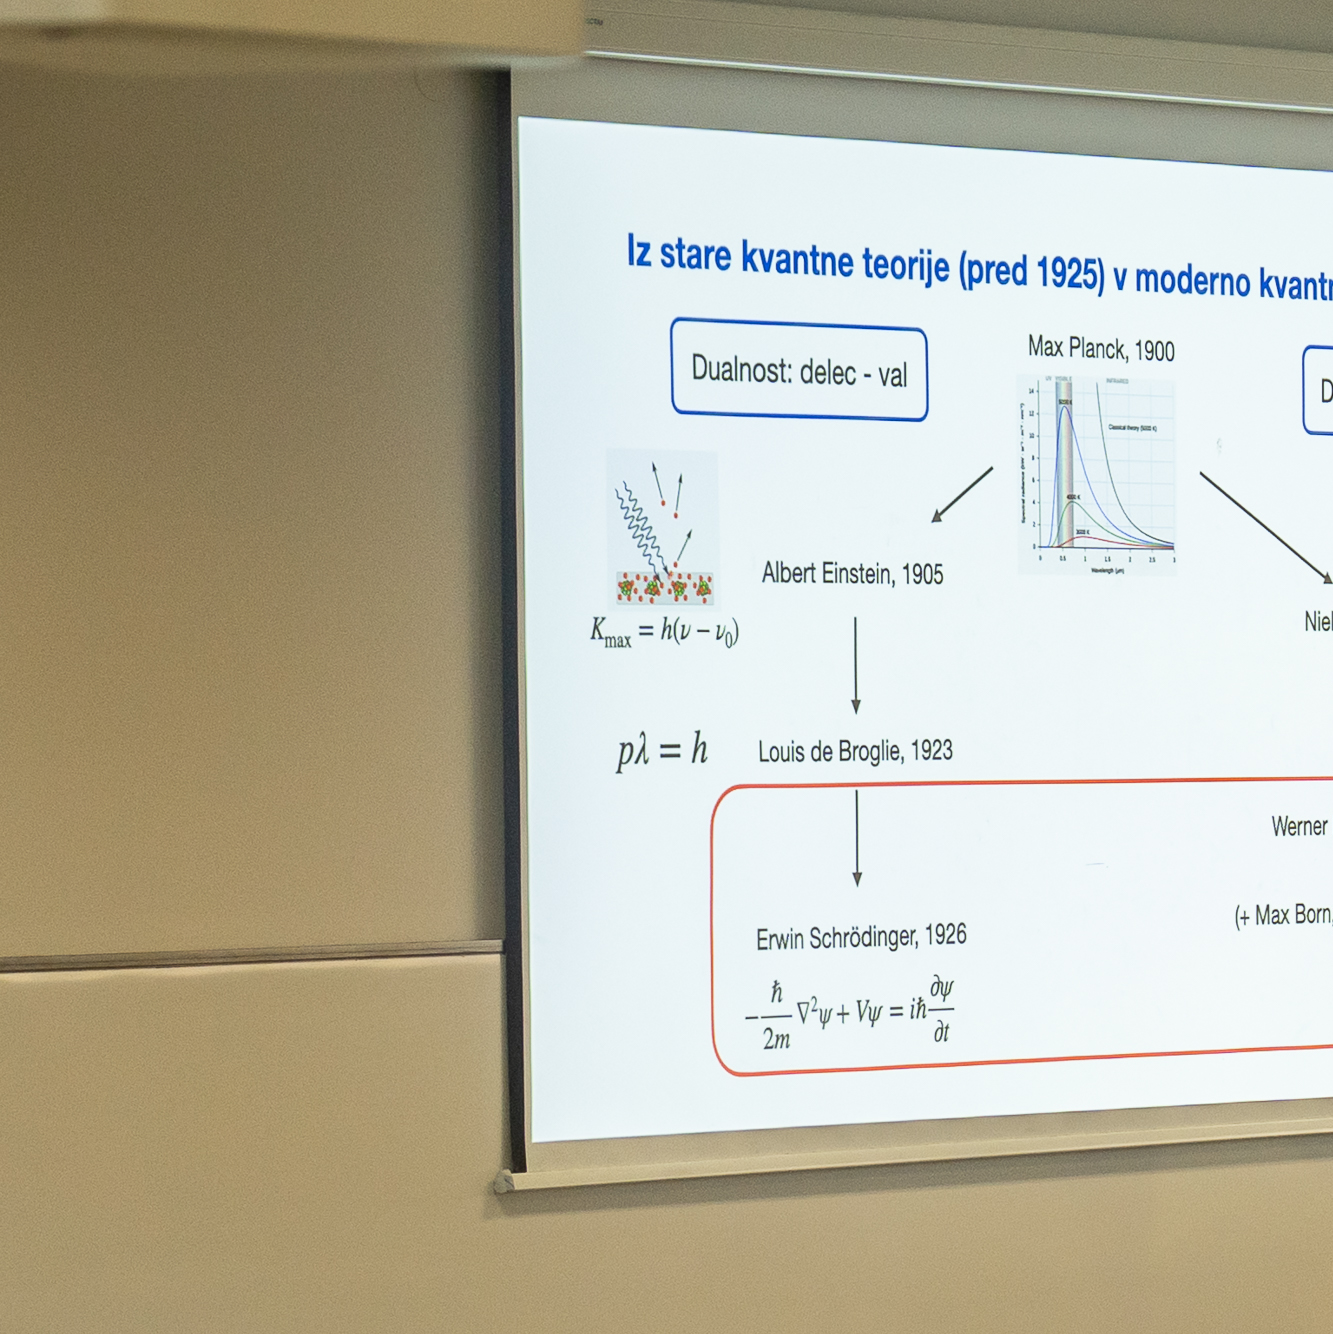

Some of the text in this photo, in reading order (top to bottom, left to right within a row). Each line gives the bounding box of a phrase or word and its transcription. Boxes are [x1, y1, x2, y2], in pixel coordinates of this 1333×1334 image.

[628, 233, 651, 266] Iz
[661, 237, 731, 271] stare
[743, 239, 854, 277] kvantne
[862, 248, 950, 288] teorije
[960, 250, 1027, 291] (pred
[1038, 256, 1104, 296] 1925)
[1114, 268, 1127, 290] v
[1136, 263, 1250, 297] moderno
[1029, 334, 1174, 363] Max Planck, 1900
[693, 353, 792, 383] Dualnost:
[801, 358, 856, 385] delec
[879, 362, 907, 387] val
[762, 561, 943, 588] Albert Einstein, 1905
[692, 730, 708, 763] h
[759, 739, 953, 767] Louis de Broglie, 1923
[1272, 816, 1328, 836] Werner
[1256, 904, 1290, 925] Max
[757, 922, 966, 952] Erwin Schrödinger, 1926
